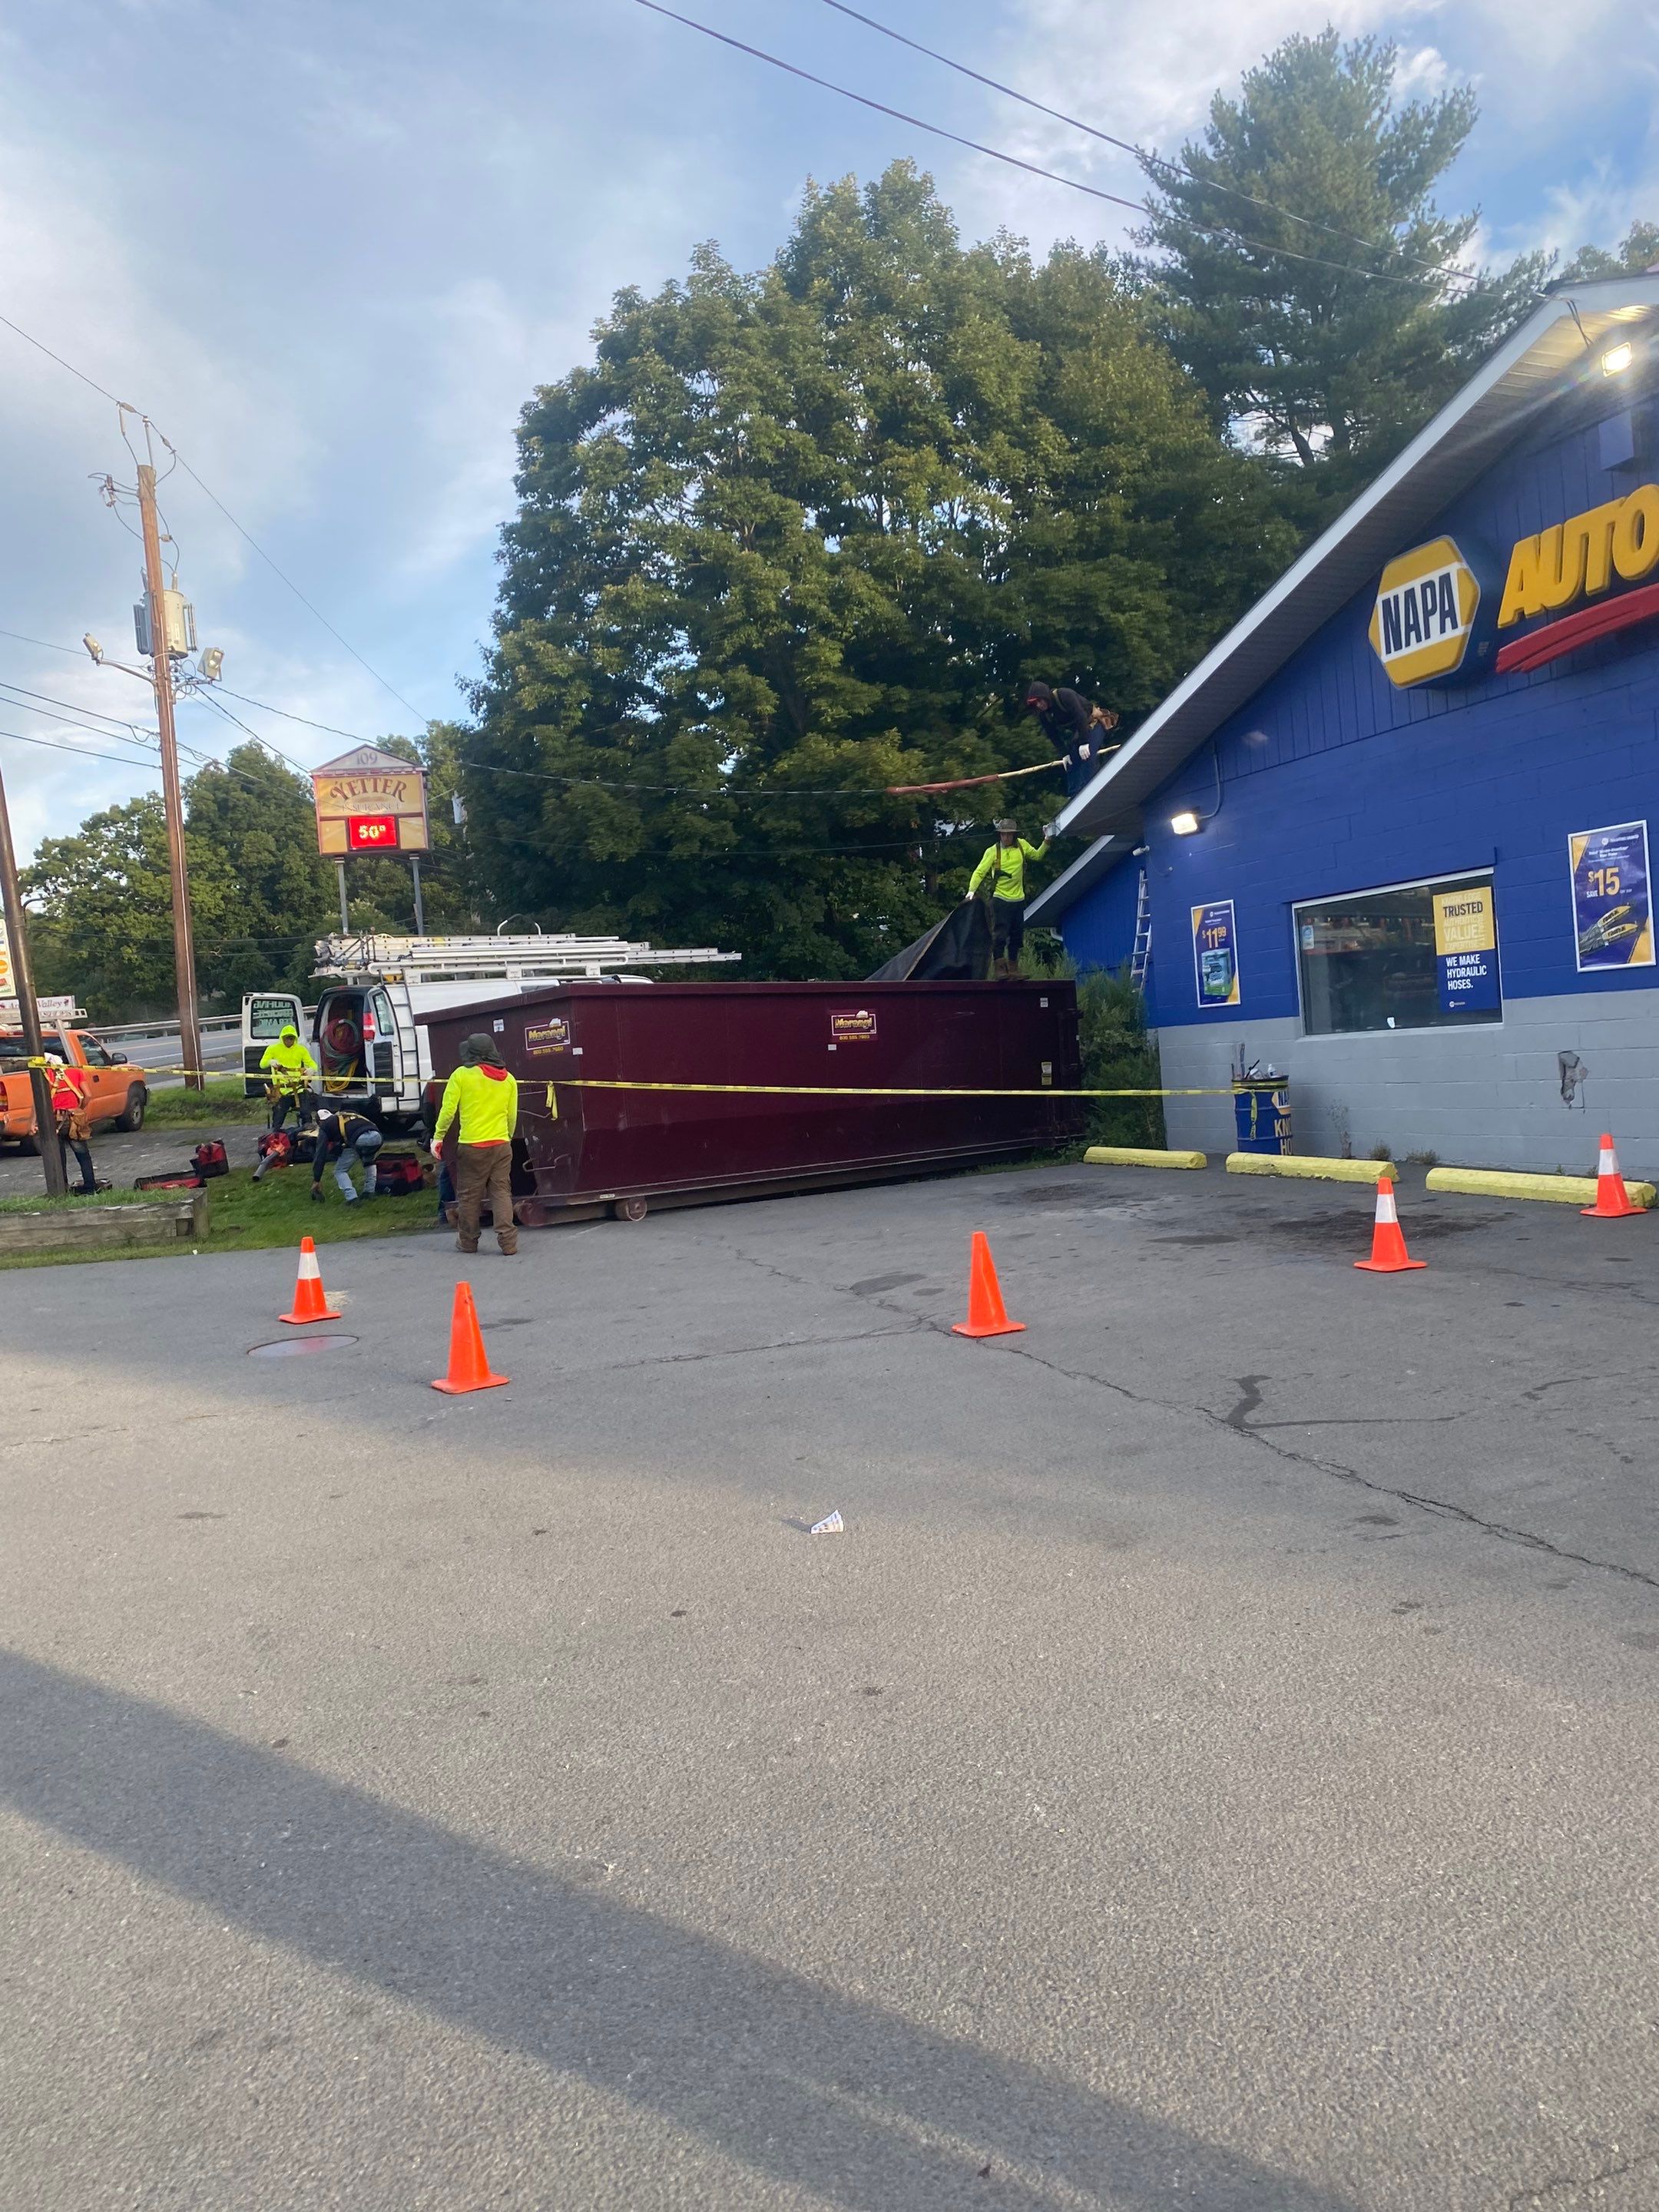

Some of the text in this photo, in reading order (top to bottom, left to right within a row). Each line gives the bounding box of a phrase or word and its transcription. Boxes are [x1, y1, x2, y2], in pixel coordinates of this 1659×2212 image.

[1382, 484, 1659, 655] NAPA AUTO
[356, 752, 378, 765] 109
[329, 777, 407, 803] YETTER
[1586, 889, 1598, 899] SAVE
[1443, 901, 1483, 918] TRUSTED
[1444, 923, 1478, 942] VALUE
[1445, 954, 1481, 967] WE MAKE
[1447, 965, 1487, 979] HYDRAULIC
[1448, 979, 1474, 991] HOSES.
